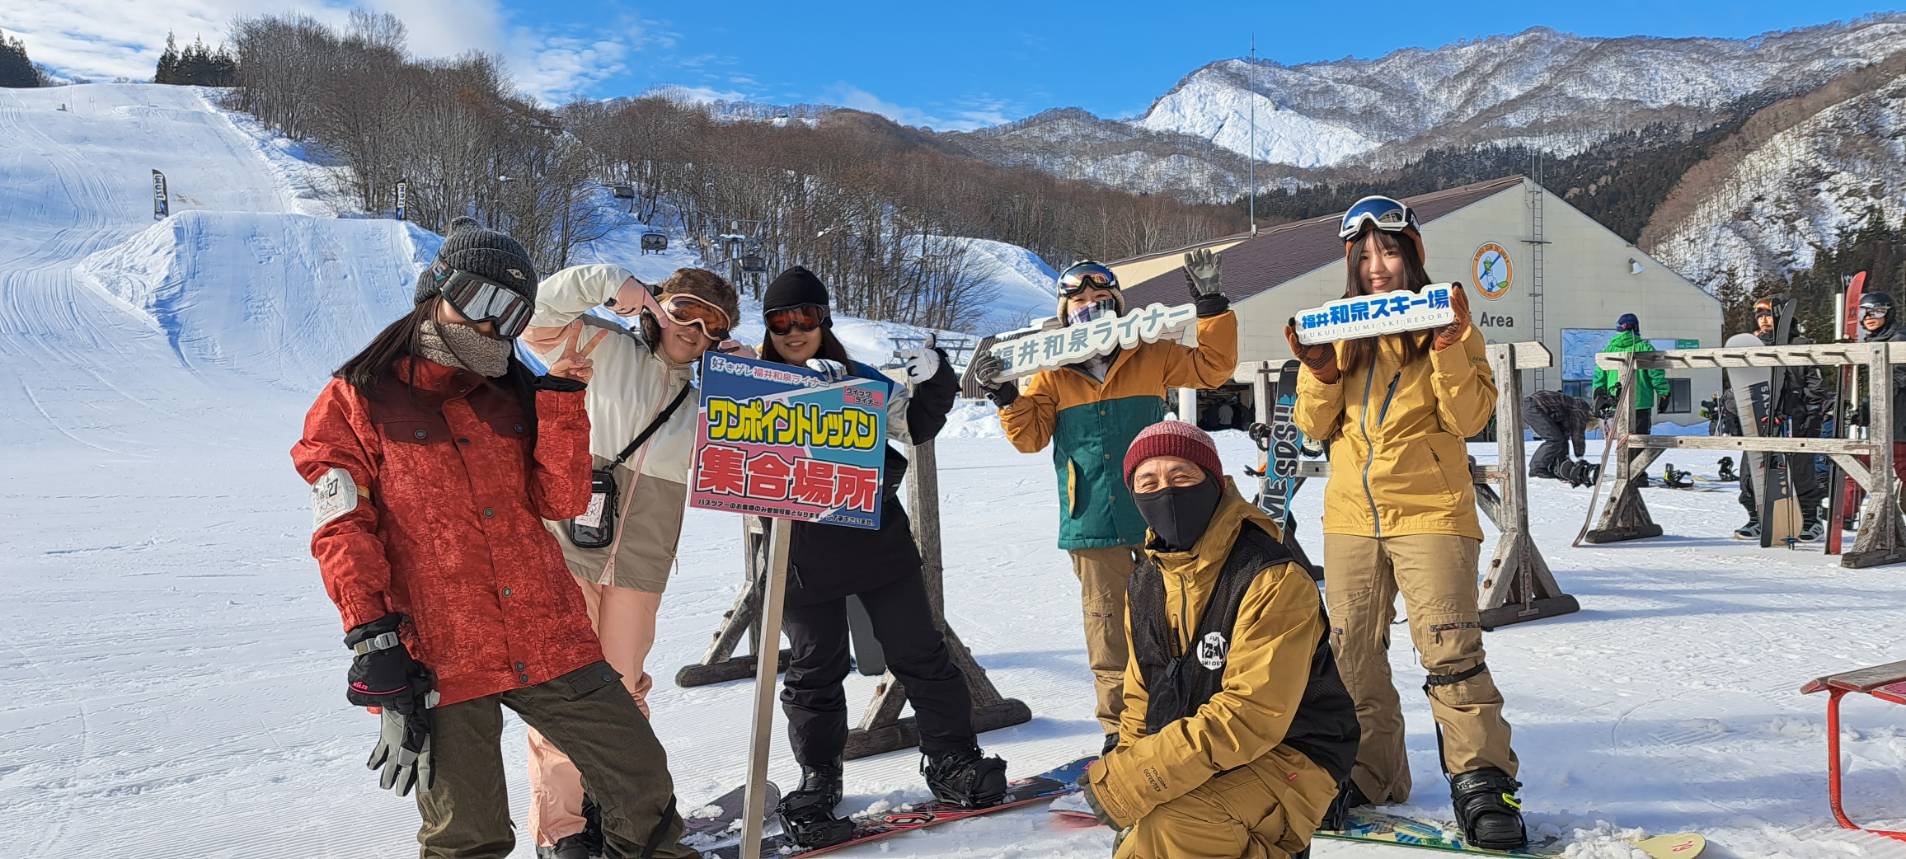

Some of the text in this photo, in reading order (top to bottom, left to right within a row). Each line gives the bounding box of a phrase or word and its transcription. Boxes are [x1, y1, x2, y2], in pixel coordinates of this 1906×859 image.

[1301, 289, 1450, 329] 福井和泉スキー場
[1303, 312, 1451, 340] FUKUI IZUMI SKI RESORT
[1480, 312, 1514, 327] Area
[707, 397, 878, 448] ワンポイントレッスン
[697, 445, 880, 513] 集合場所
